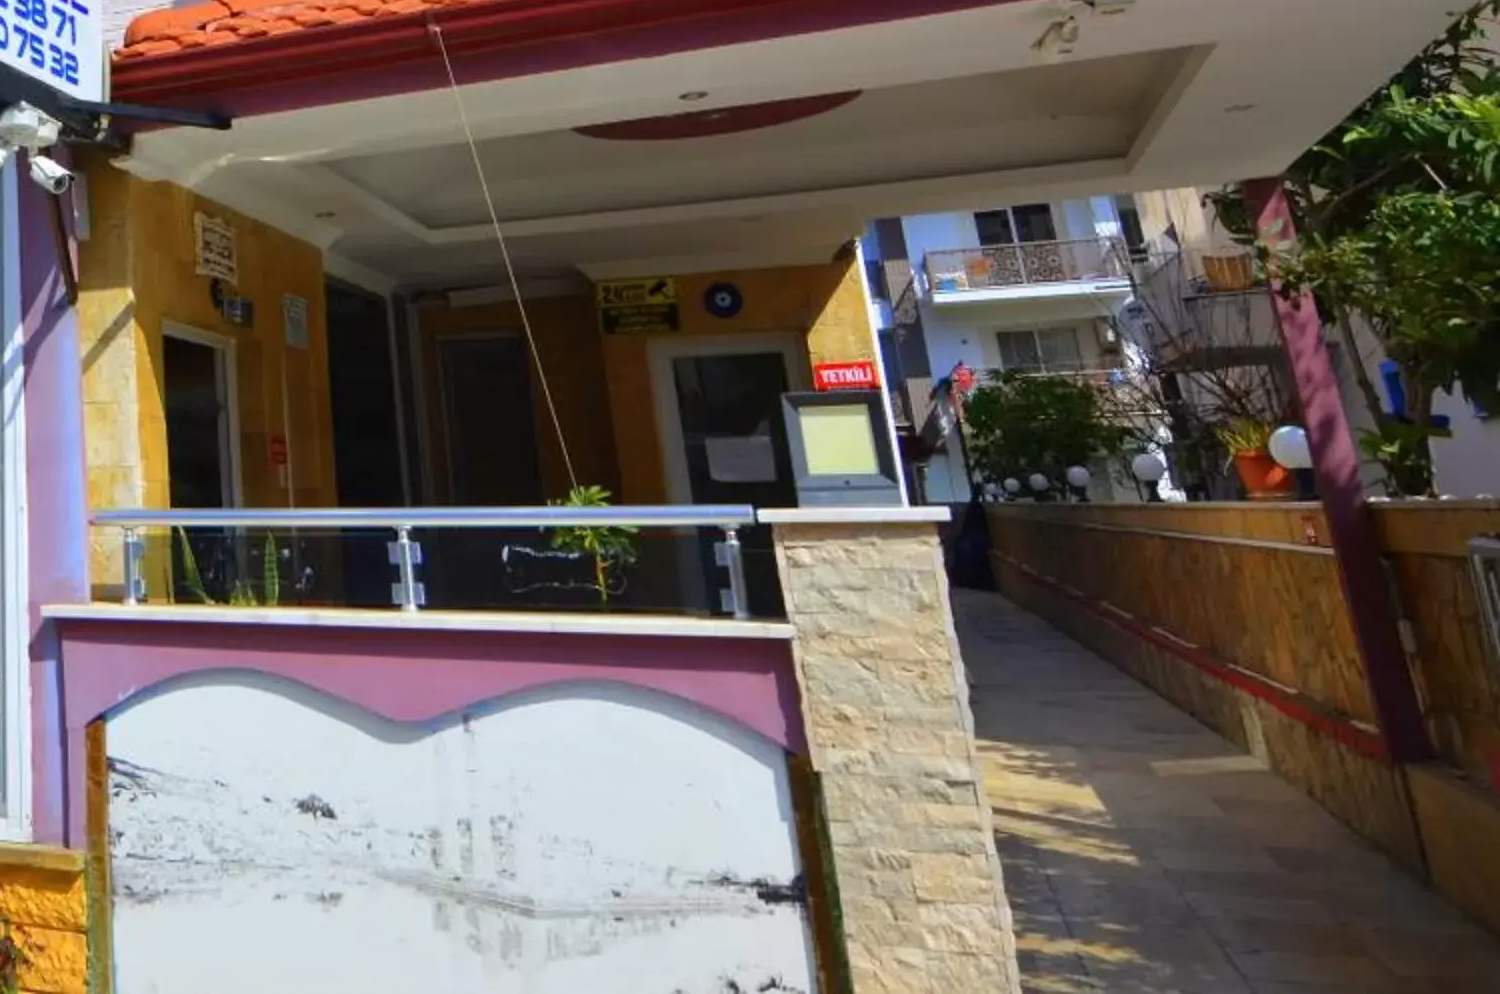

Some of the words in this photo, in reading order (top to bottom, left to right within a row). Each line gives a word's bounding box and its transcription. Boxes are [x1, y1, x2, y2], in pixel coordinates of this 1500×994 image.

[51, 4, 77, 46] 71
[12, 22, 46, 70] 75
[49, 42, 80, 87] 32
